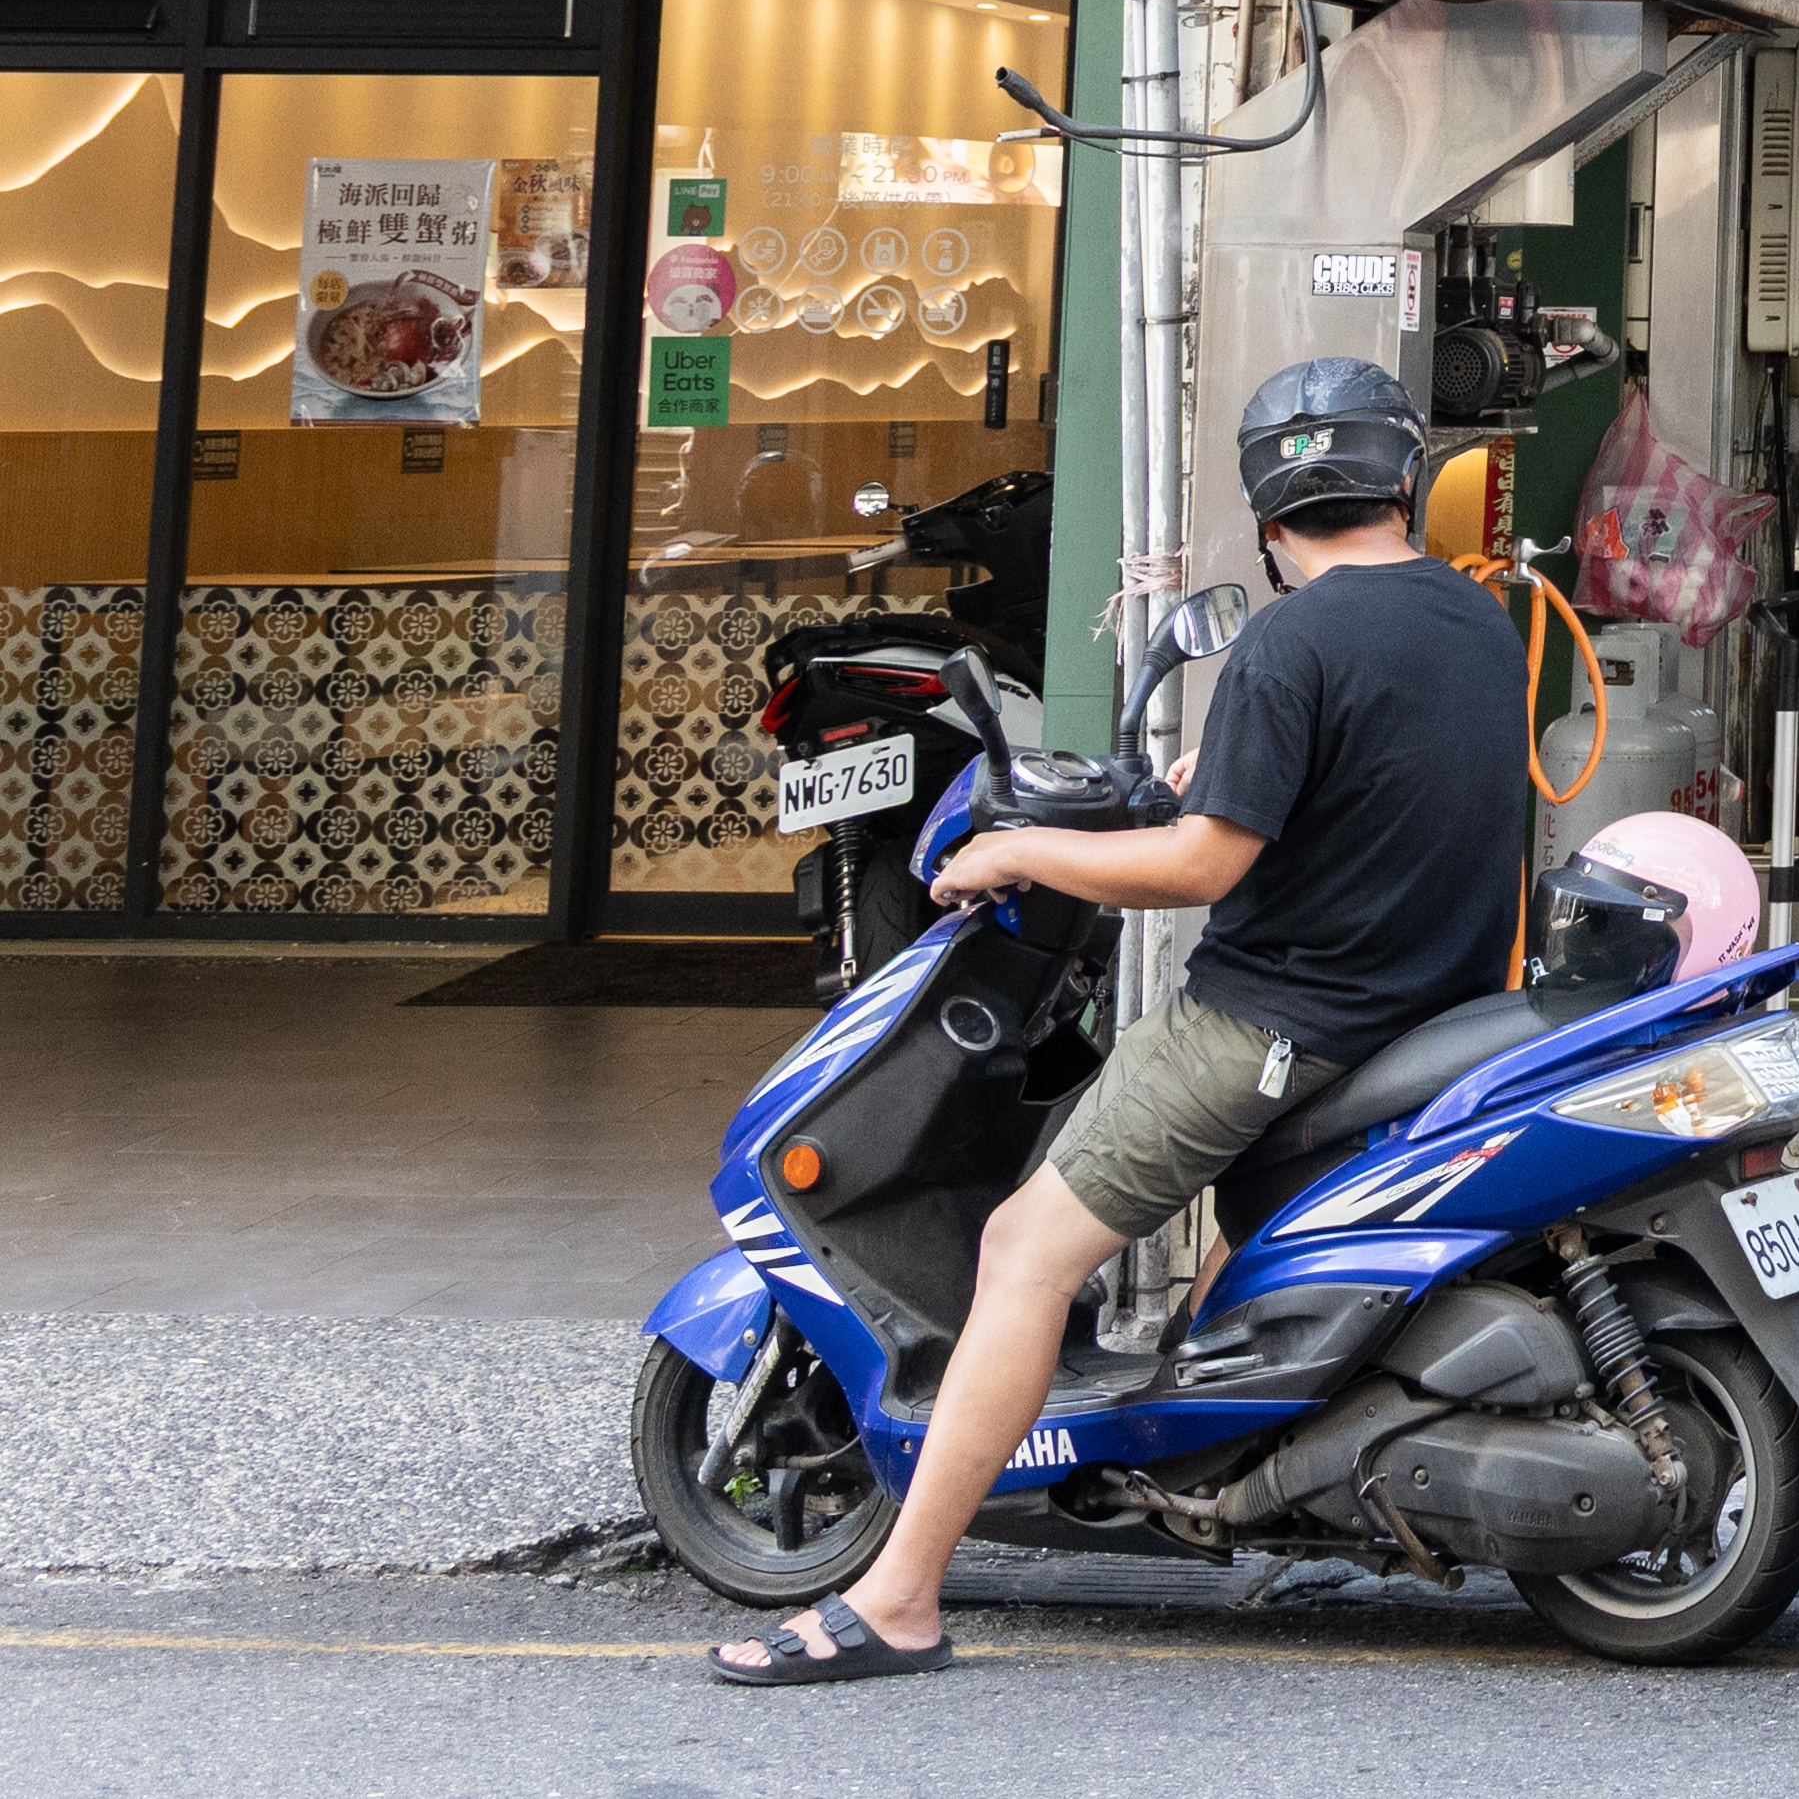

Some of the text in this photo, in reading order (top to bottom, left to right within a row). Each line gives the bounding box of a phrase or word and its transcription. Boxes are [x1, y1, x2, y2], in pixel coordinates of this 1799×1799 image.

[338, 182, 442, 208] 海派回歸
[1313, 254, 1396, 284] CRUDE
[664, 350, 717, 370] Uber
[663, 373, 716, 392] Eats
[657, 398, 720, 415] 合作商家
